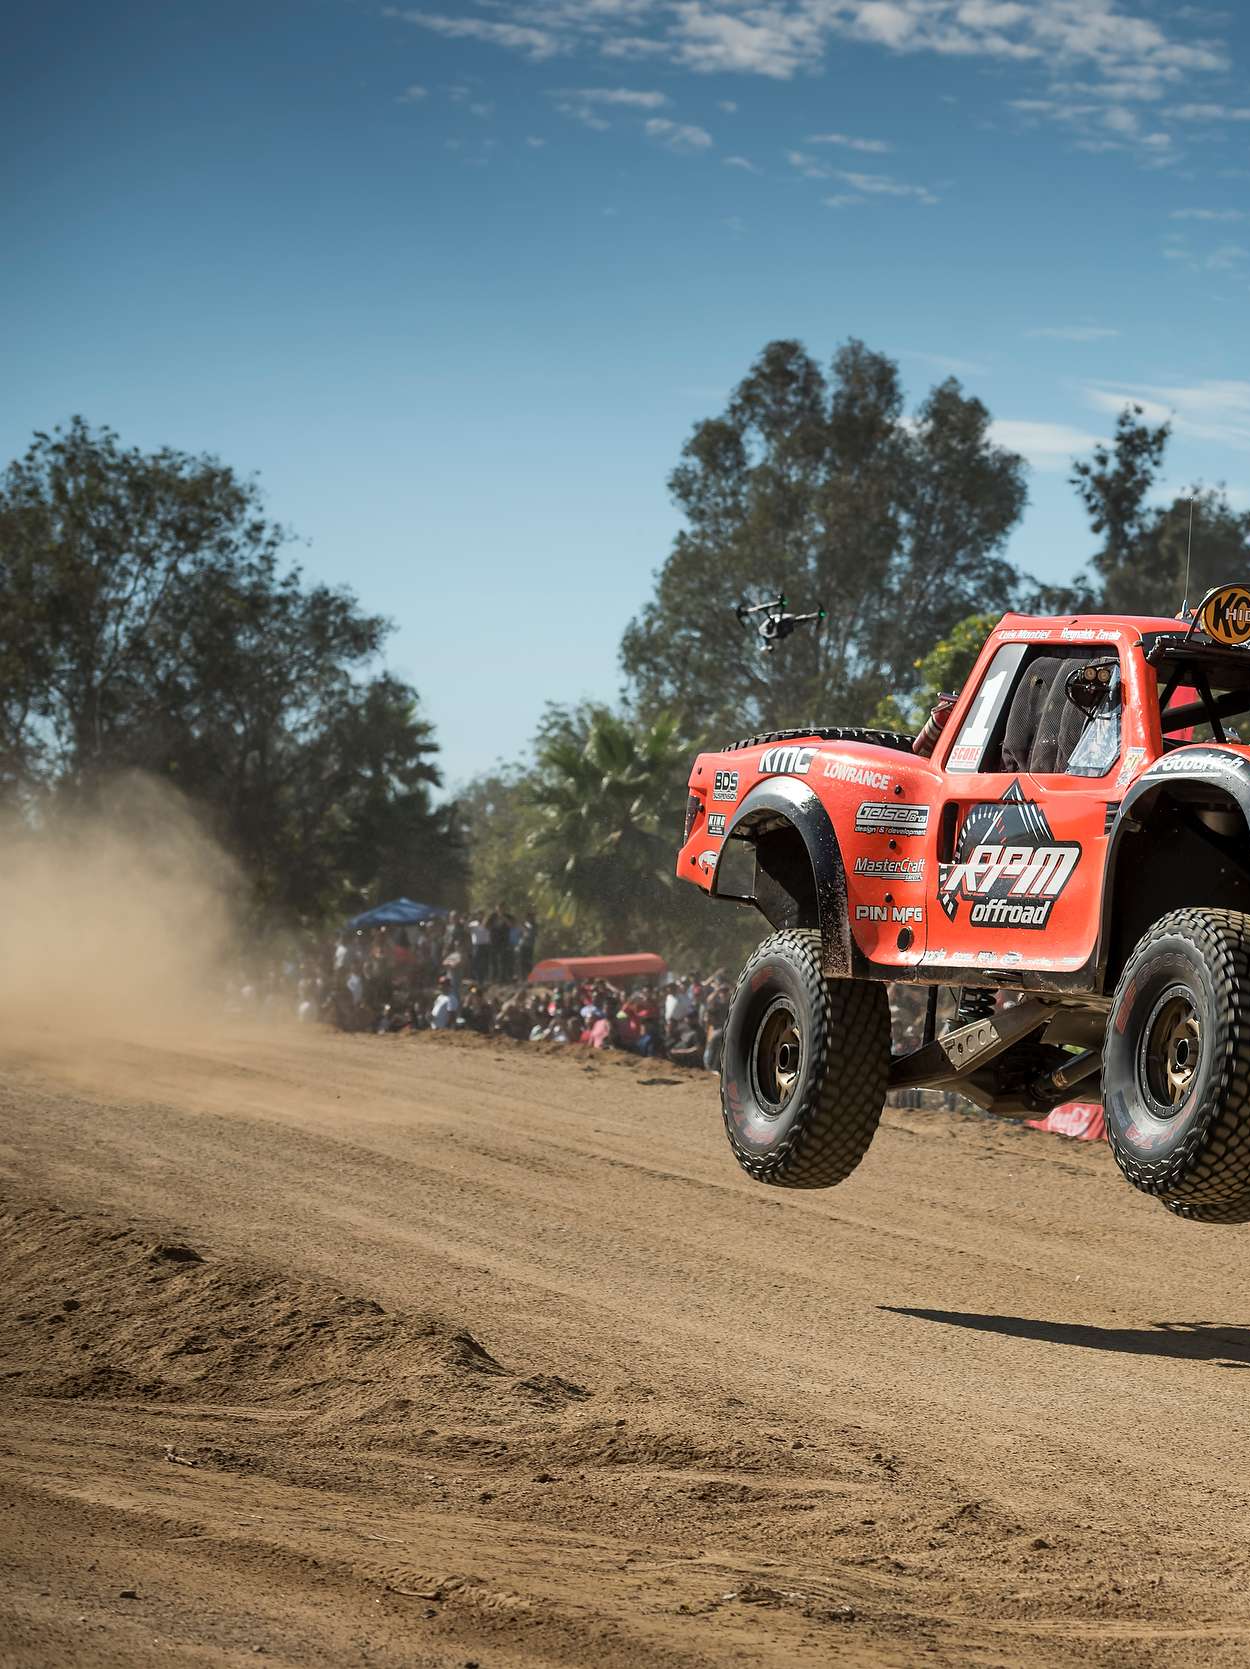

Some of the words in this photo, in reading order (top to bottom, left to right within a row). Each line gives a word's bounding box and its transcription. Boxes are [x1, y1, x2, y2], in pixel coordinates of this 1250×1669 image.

[959, 671, 1008, 745] 1
[951, 747, 981, 761] SCORE
[715, 771, 739, 791] BDS
[824, 763, 891, 791] LOWRANCE
[708, 815, 726, 826] KING
[855, 857, 926, 873] MasterCraft
[943, 845, 1080, 895] RPM
[856, 906, 888, 921] PIN
[892, 906, 923, 923] MFG
[971, 899, 1052, 924] offroad
